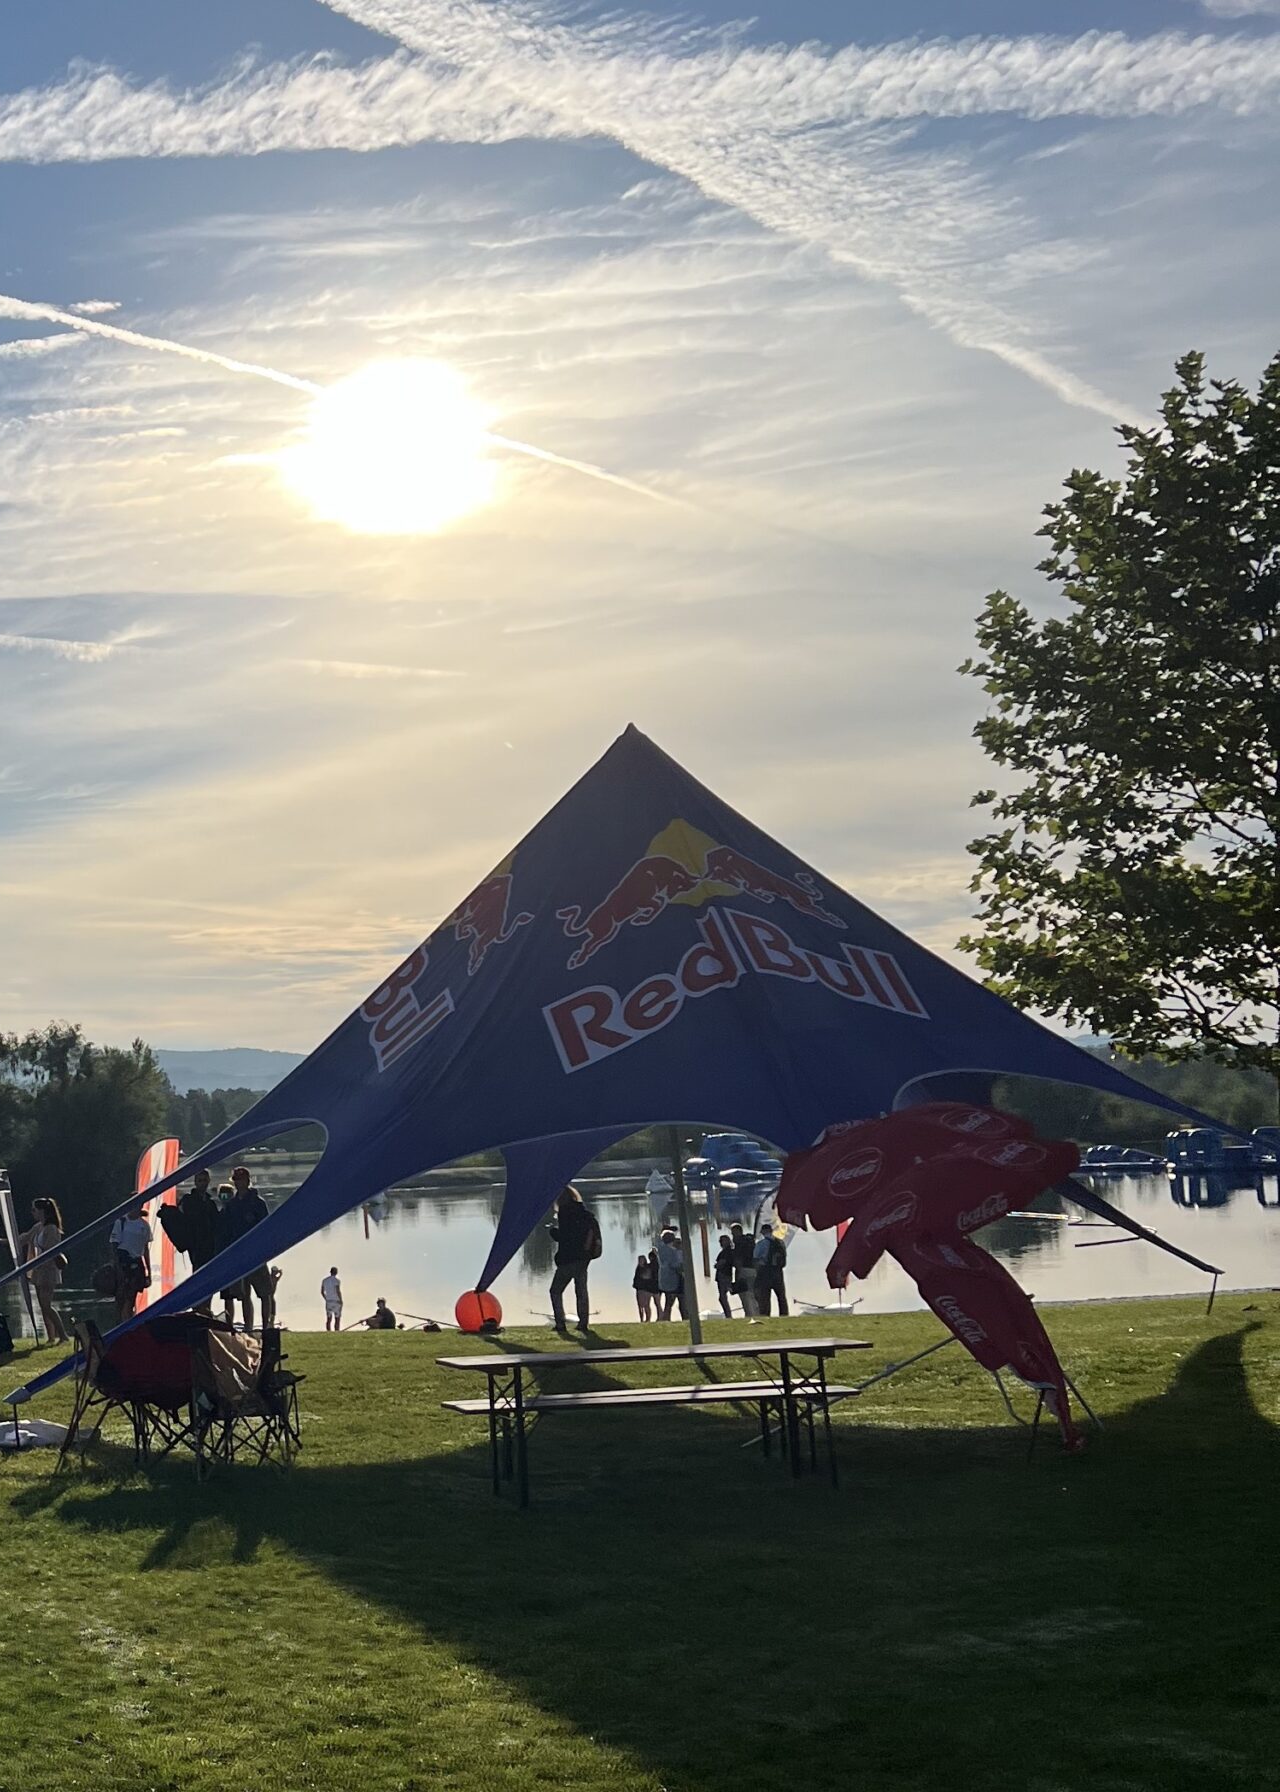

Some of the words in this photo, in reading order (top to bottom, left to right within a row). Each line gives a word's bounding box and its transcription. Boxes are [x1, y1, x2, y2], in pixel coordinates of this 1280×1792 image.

[359, 946, 456, 1073] Bull
[541, 906, 747, 1075] Red
[723, 907, 931, 1021] Bull
